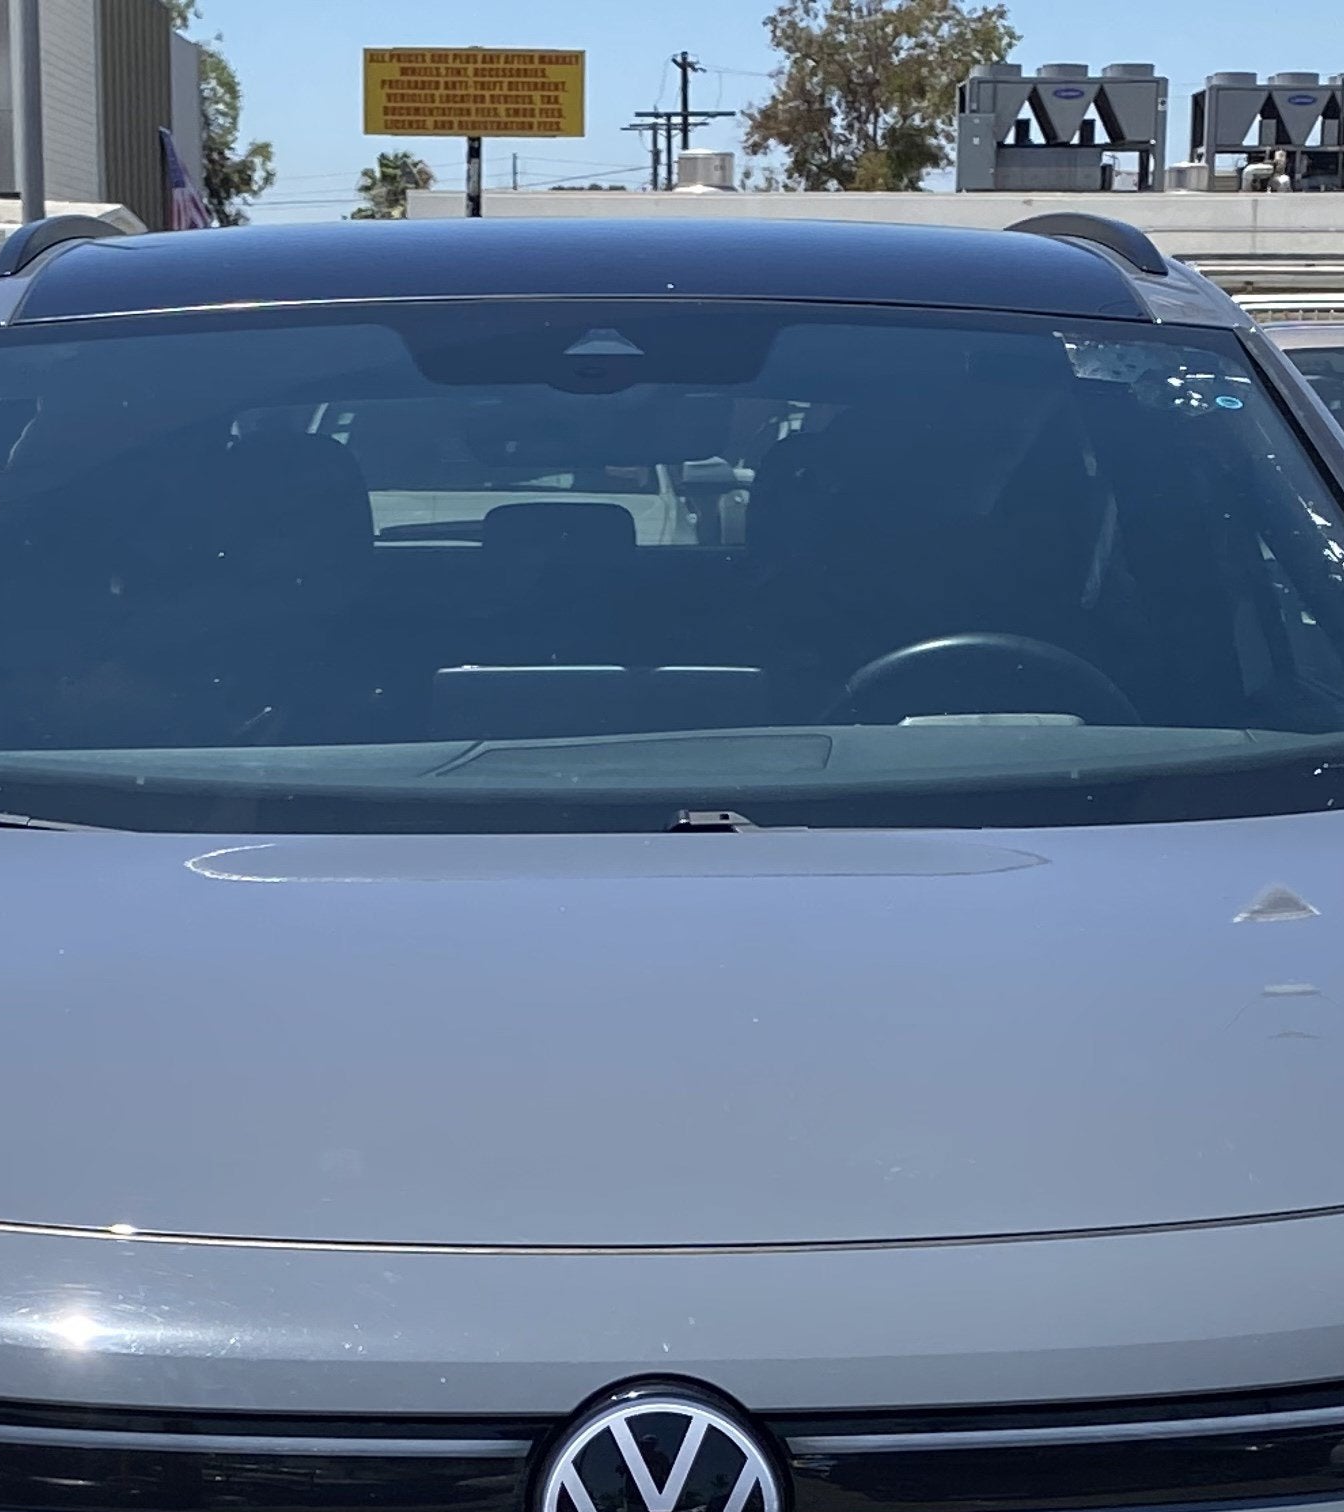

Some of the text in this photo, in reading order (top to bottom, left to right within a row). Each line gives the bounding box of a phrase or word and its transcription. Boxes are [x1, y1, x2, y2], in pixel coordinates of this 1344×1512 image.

[368, 53, 579, 65] ALL PRICES ARE PLUS ANY AFTER MARKET
[432, 119, 454, 131] AND
